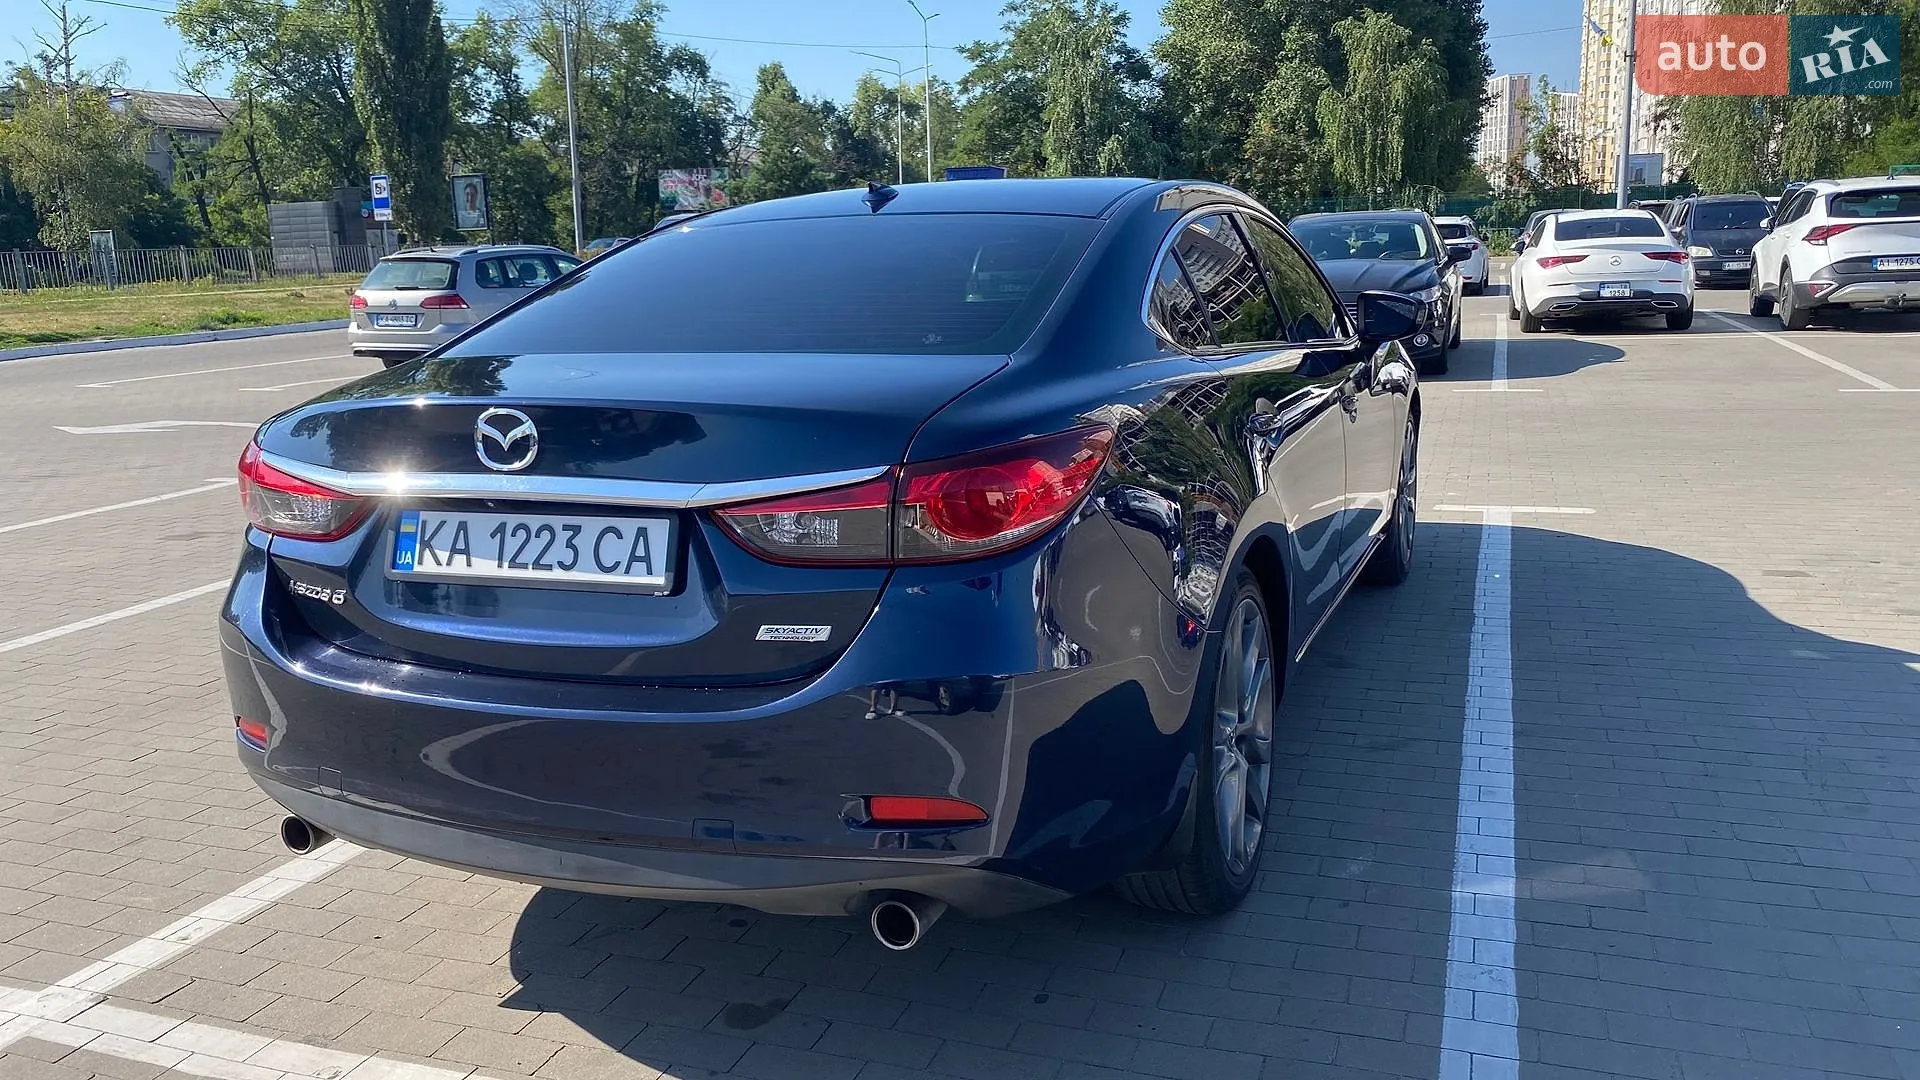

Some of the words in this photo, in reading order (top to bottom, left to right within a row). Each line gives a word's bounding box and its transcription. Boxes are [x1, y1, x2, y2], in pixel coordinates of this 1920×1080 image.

[1895, 257, 1914, 266] 1275
[417, 520, 472, 567] KA
[489, 521, 582, 572] 1223
[593, 526, 653, 576] CA
[396, 549, 412, 565] UA
[332, 589, 347, 605] 6
